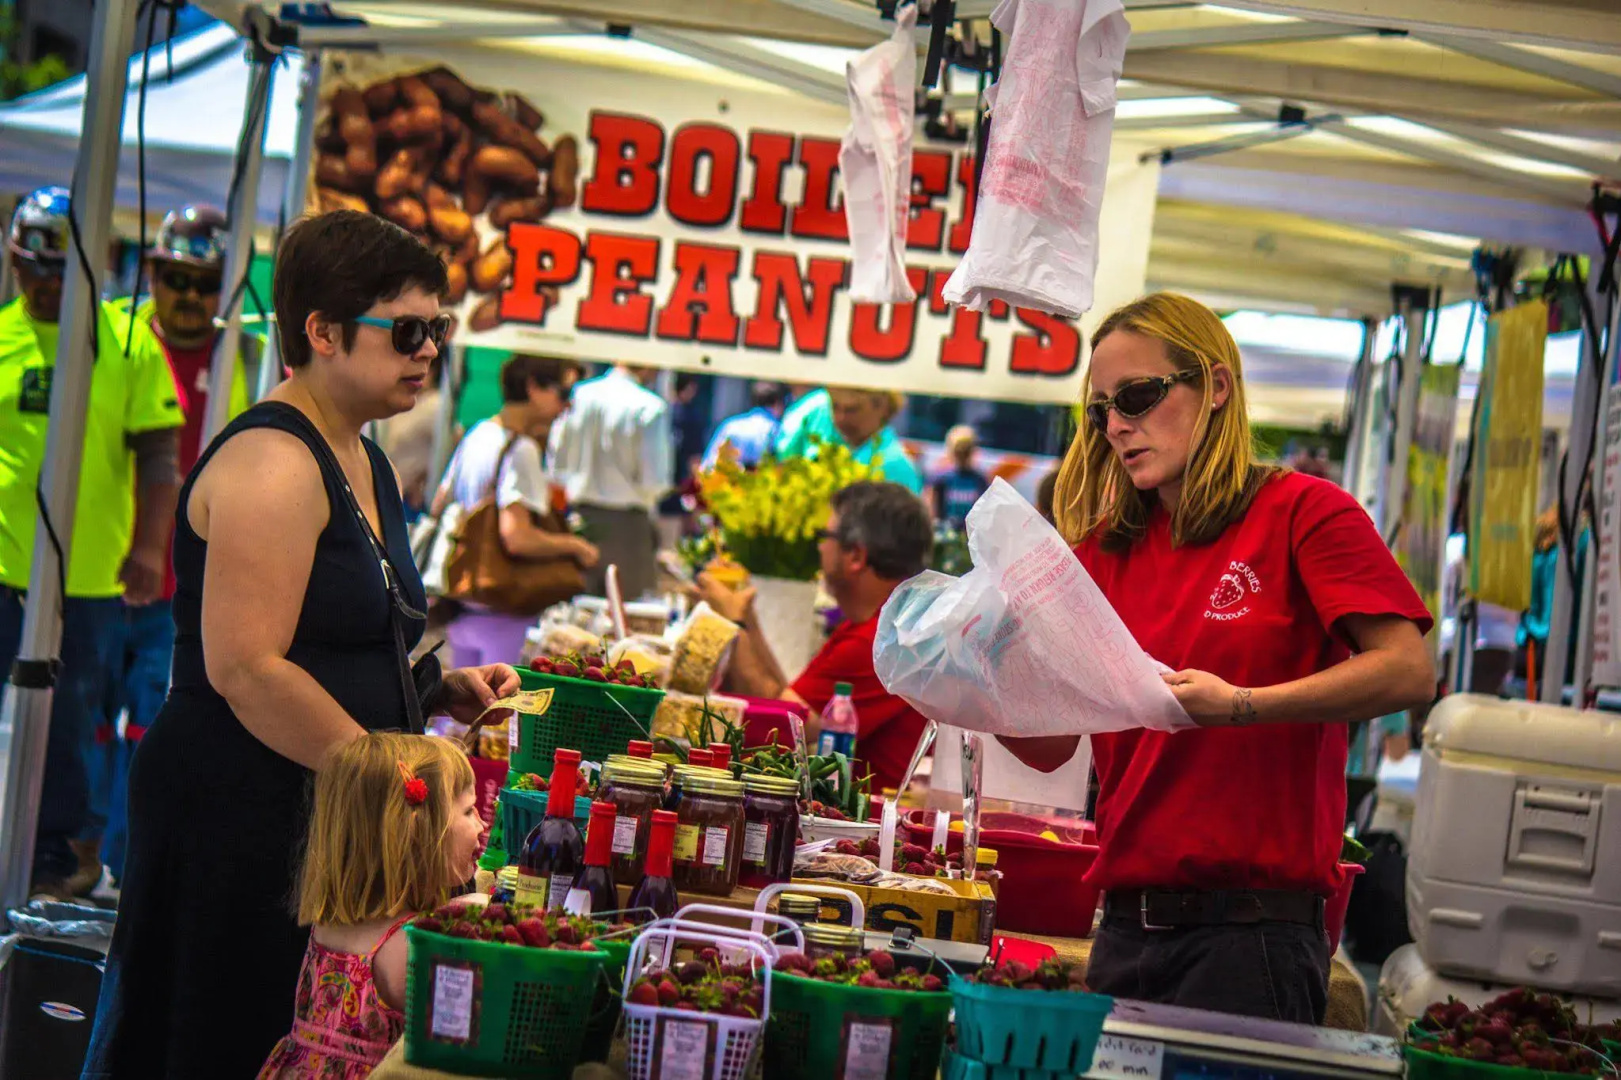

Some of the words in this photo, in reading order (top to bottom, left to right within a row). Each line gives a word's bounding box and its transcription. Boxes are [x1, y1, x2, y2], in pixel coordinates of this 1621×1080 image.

[499, 220, 1082, 377] PEANUTS
[1229, 561, 1261, 592] BERRIES
[1211, 607, 1250, 620] PRODUCE
